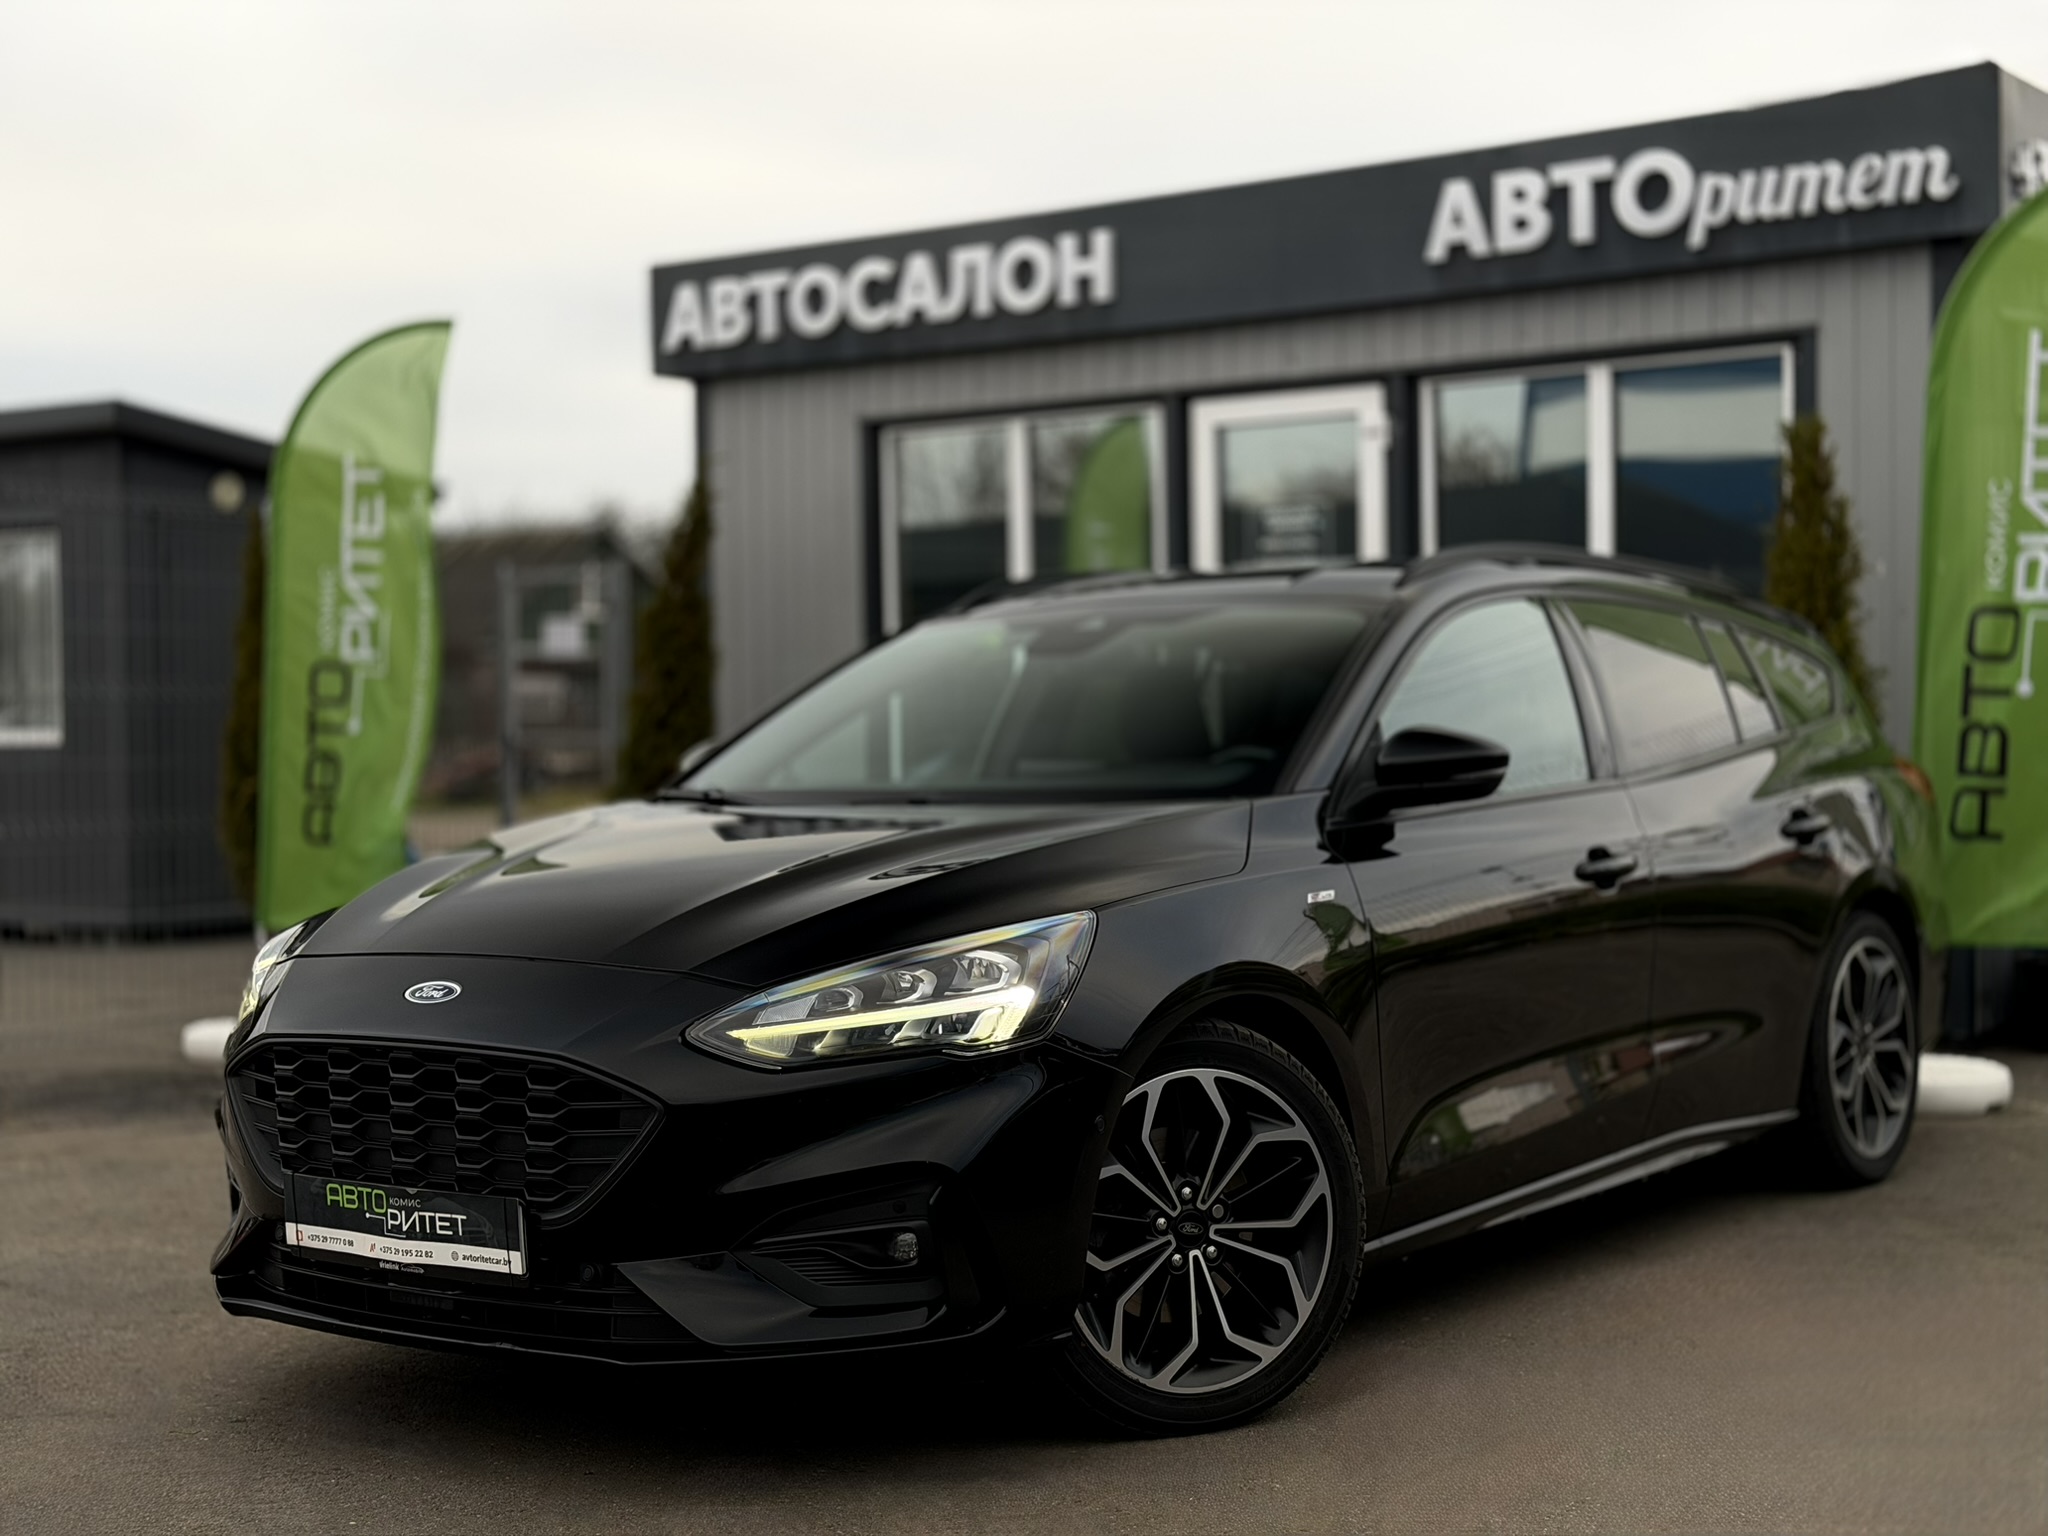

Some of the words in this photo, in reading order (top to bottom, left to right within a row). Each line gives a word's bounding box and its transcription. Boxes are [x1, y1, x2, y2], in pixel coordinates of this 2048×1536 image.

[659, 225, 1116, 355] АВТОСАЛОН
[1985, 474, 2013, 592] КОМИС
[1949, 604, 2022, 844] АВТО
[415, 984, 449, 998] Ford
[326, 1183, 387, 1214] АВТО
[389, 1197, 421, 1208] КОМИС
[387, 1208, 467, 1236] РИТЕТ
[307, 1233, 321, 1243] +375
[321, 1235, 328, 1243] 29
[329, 1236, 342, 1245] 7777
[342, 1238, 347, 1246] 0
[379, 1246, 393, 1255] +375
[393, 1247, 400, 1256] 29
[401, 1248, 414, 1257] 195
[414, 1249, 423, 1258] 22
[424, 1250, 433, 1259] 82
